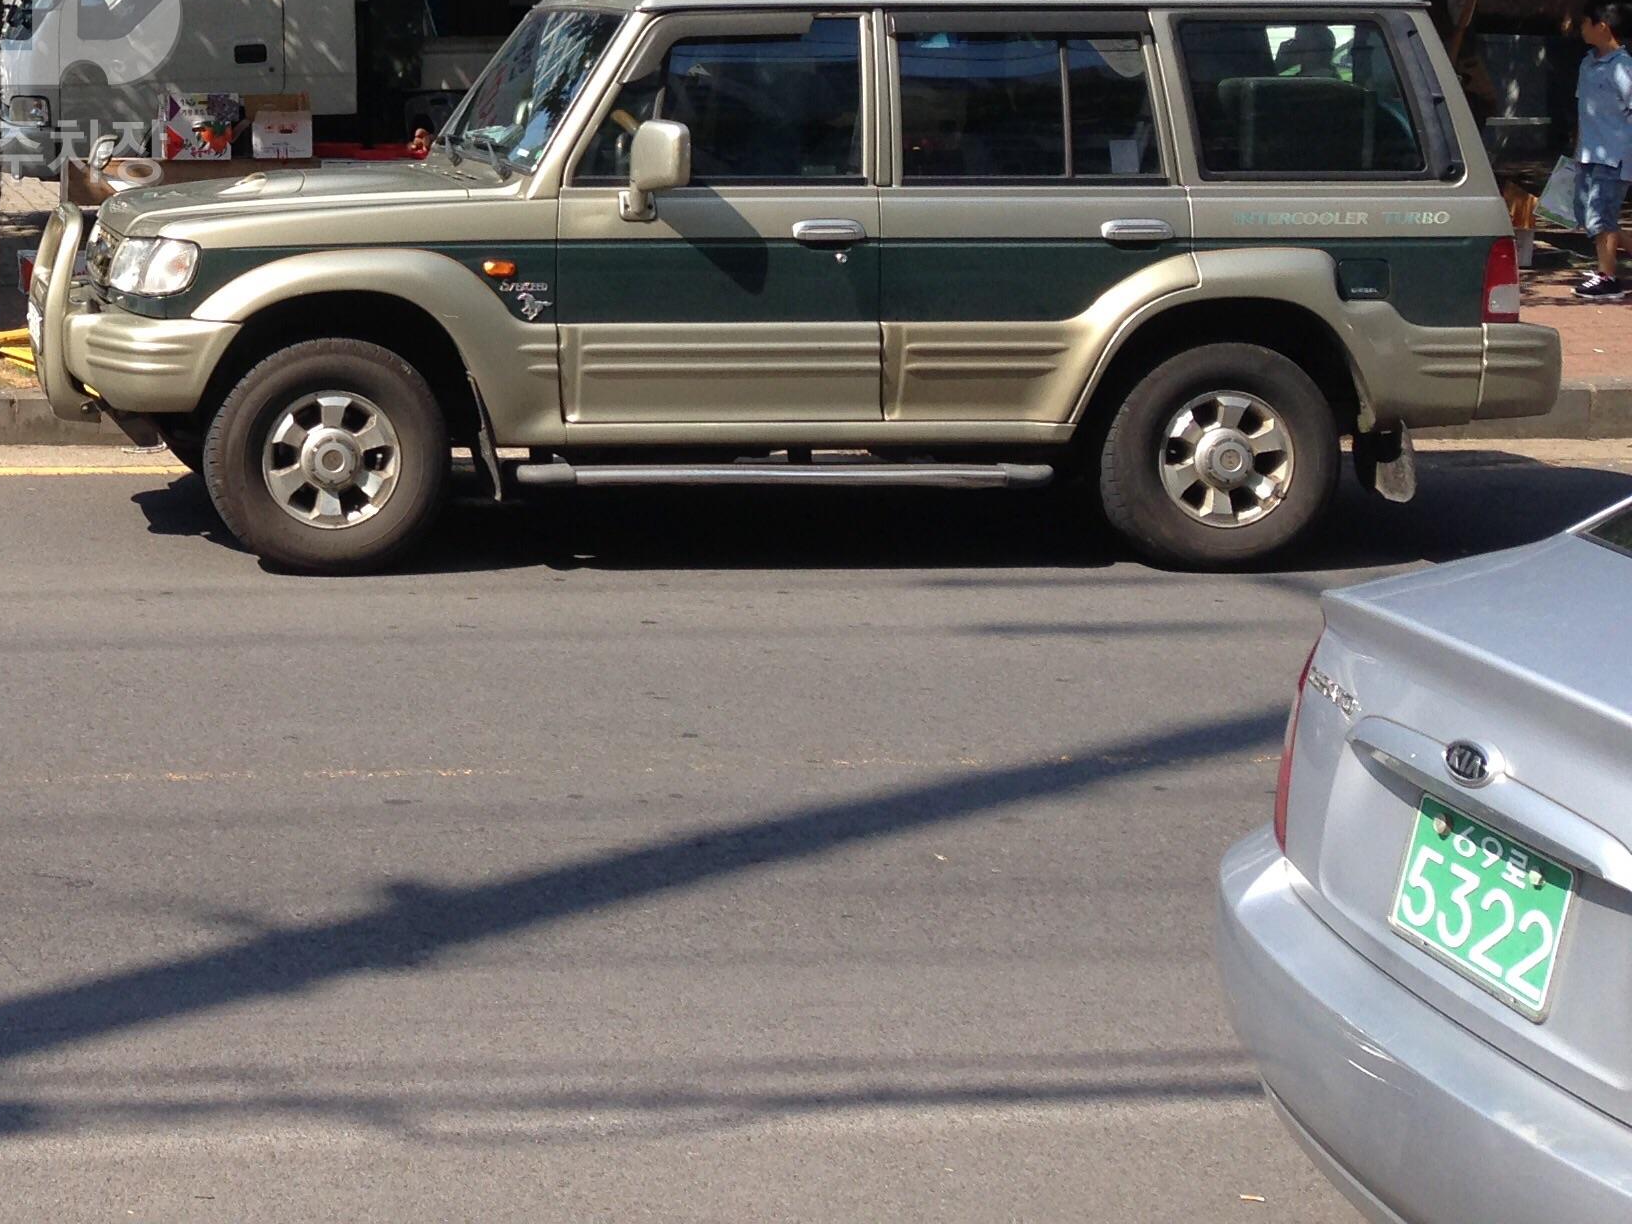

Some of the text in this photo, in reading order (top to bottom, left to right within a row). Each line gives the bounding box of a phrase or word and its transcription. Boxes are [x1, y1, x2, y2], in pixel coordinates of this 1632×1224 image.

[1233, 210, 1450, 225] INTERCOOLER TURBO
[1401, 844, 1553, 1003] 5322
